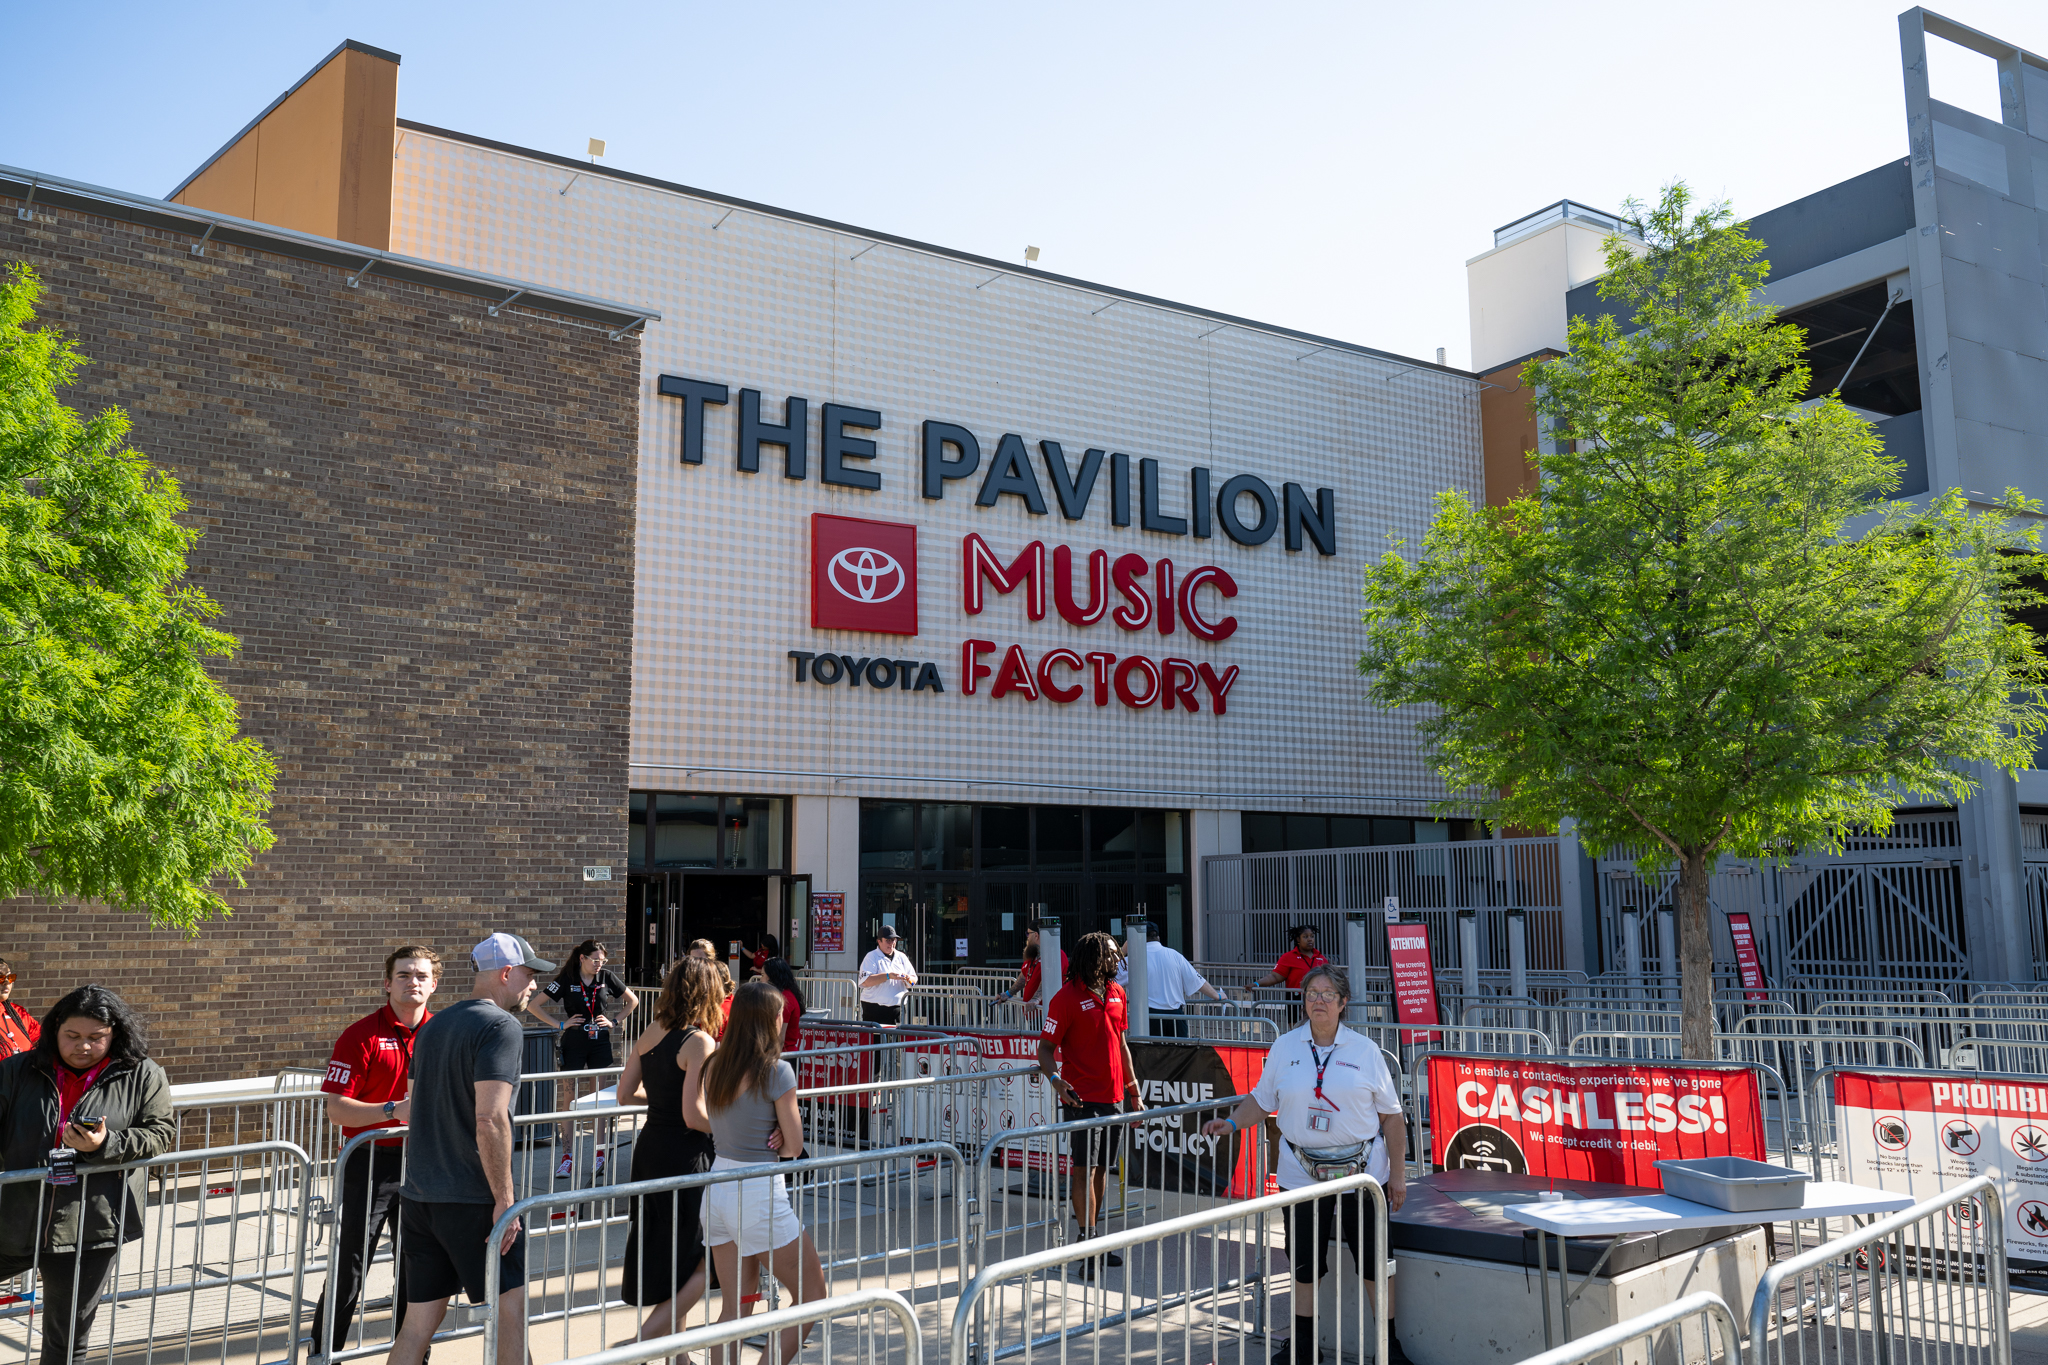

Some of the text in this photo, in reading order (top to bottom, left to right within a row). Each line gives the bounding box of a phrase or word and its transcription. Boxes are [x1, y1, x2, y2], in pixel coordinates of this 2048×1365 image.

[658, 373, 1337, 557] THE PAVILION
[963, 532, 1239, 642] MUSIC
[788, 650, 945, 693] TOYOTA
[962, 639, 1241, 715] FACTORY
[587, 869, 595, 878] NO
[1390, 936, 1426, 951] ATTENTION
[1406, 961, 1426, 969] screening
[1396, 970, 1418, 978] technology
[1411, 979, 1428, 987] improve
[1398, 988, 1430, 998] your experience
[1403, 998, 1420, 1006] entering
[1009, 1038, 1040, 1056] ITEM
[326, 1066, 351, 1084] 218
[1459, 1064, 1721, 1091] To enable a contactless experience, we've gone
[1140, 1079, 1214, 1104] VENUE
[1456, 1080, 1727, 1135] CASHLESS!
[811, 1108, 835, 1122] ASH
[1134, 1128, 1221, 1157] POLICY
[1530, 1131, 1661, 1151] We accept credit or debit.
[1867, 1159, 1893, 1167] backpacks
[1894, 1161, 1909, 1169] larger
[1950, 1158, 1975, 1166] Weapons
[2017, 1164, 2033, 1172] Illegal
[1932, 1170, 1957, 1178] including
[1966, 1166, 1979, 1174] kind,
[2008, 1177, 2033, 1185] including
[2006, 1238, 2037, 1247] Fireworks,
